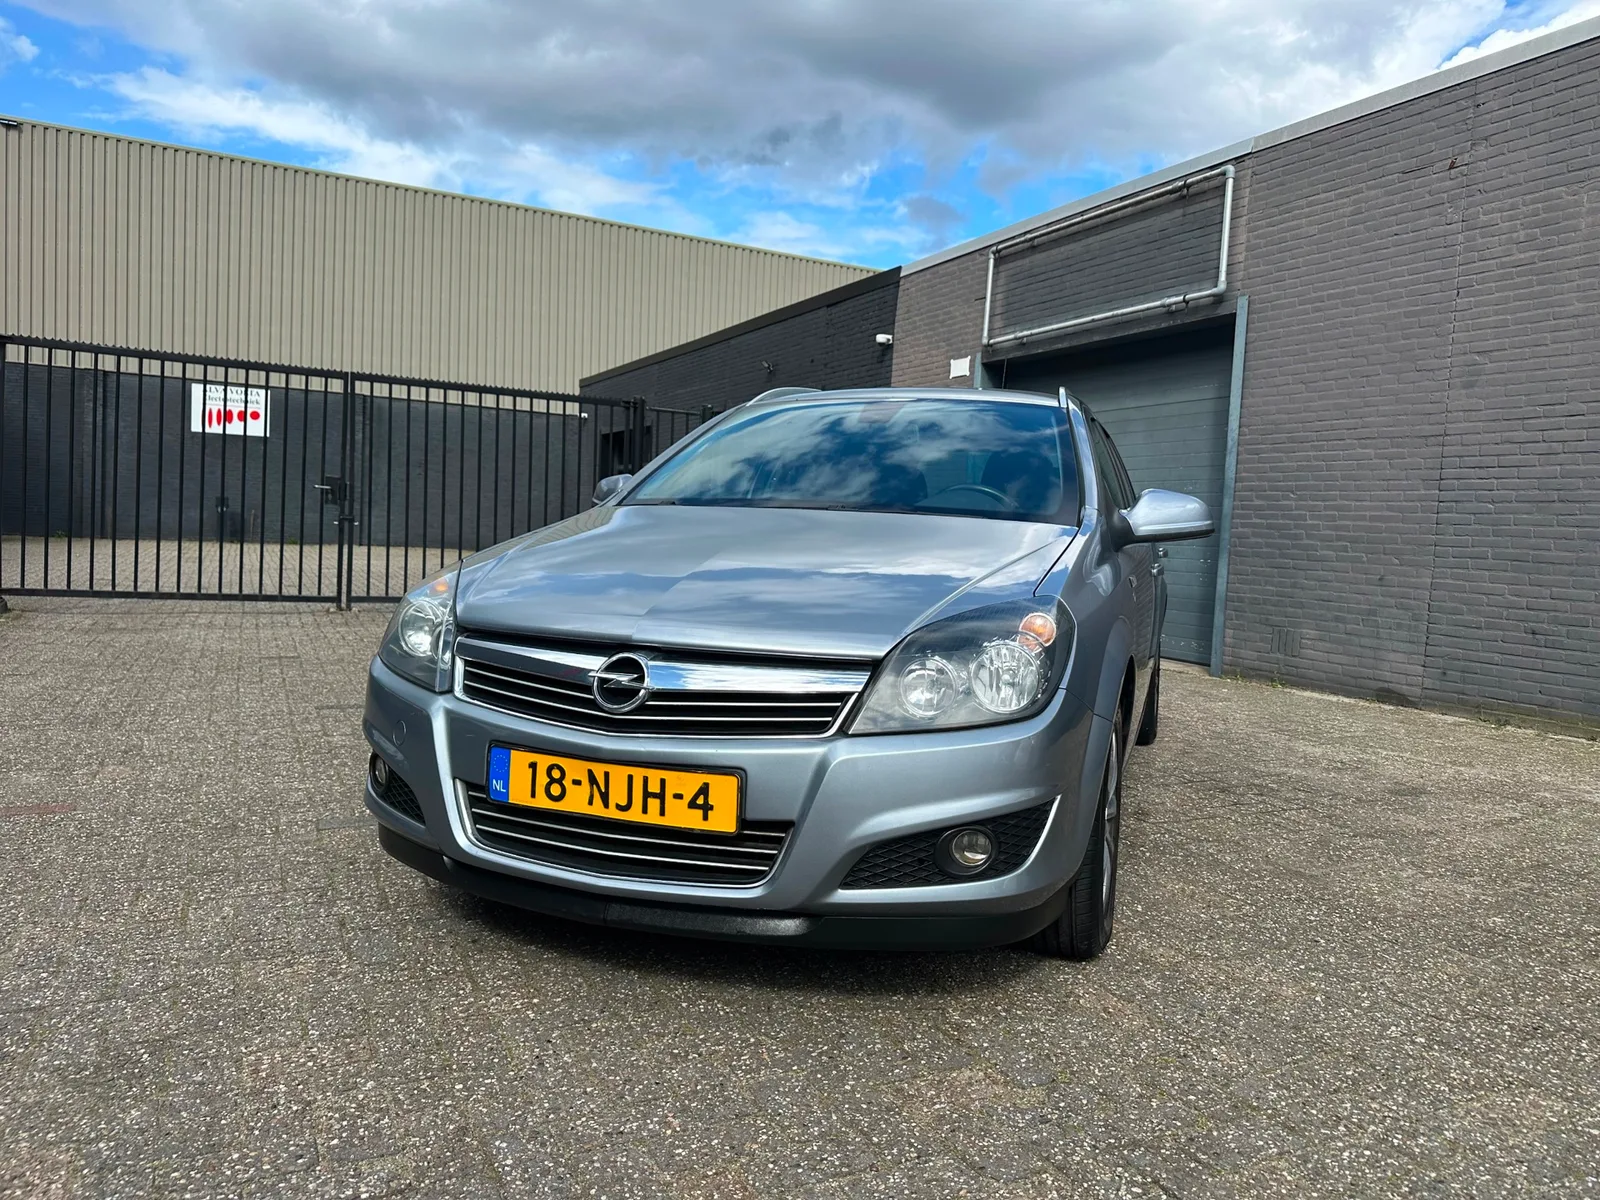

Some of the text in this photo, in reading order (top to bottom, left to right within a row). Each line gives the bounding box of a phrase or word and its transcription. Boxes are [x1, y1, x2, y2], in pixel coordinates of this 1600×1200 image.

[203, 385, 261, 397] LV VOTA
[203, 394, 261, 405] lecttechiek
[492, 778, 506, 793] NL
[528, 760, 714, 822] 18-NJH-4
